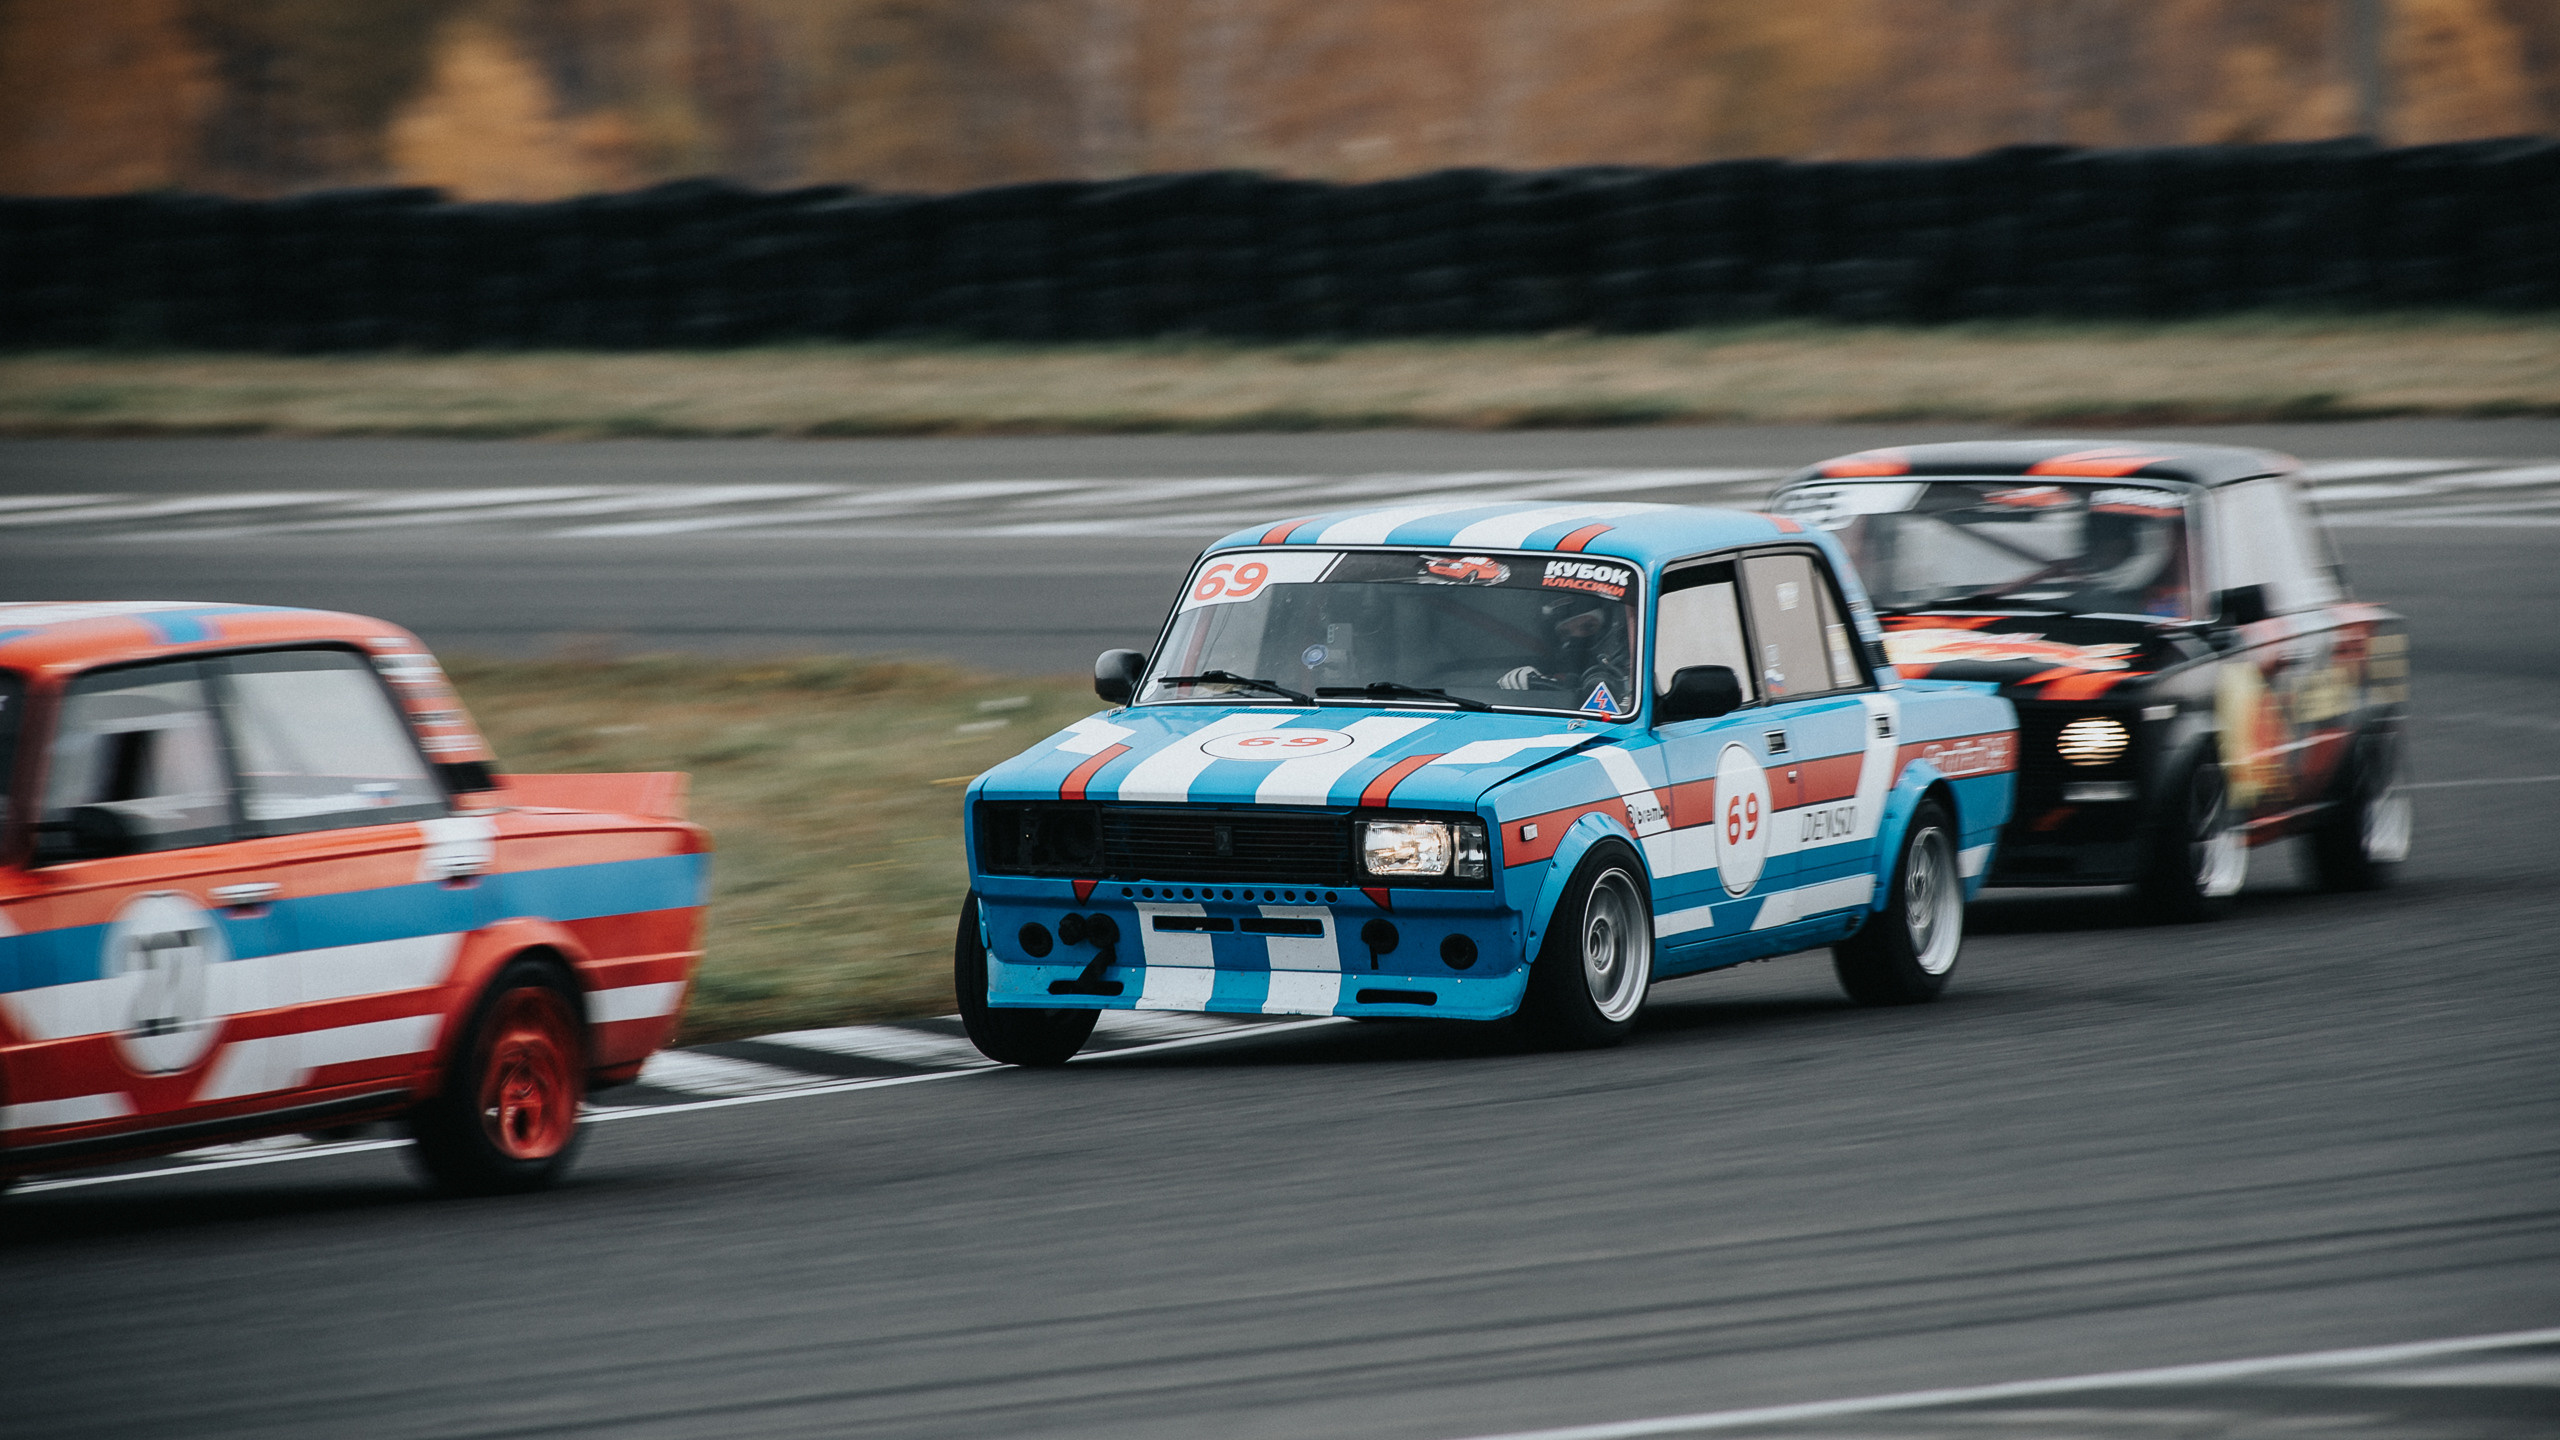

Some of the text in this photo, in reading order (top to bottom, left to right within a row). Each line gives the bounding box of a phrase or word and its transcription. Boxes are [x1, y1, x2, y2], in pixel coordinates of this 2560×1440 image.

[1193, 562, 1268, 601] 69
[1543, 560, 1631, 587] КУБОК
[1541, 577, 1626, 598] КЛАССИКИ
[1238, 736, 1328, 747] 69
[1728, 792, 1758, 846] 69
